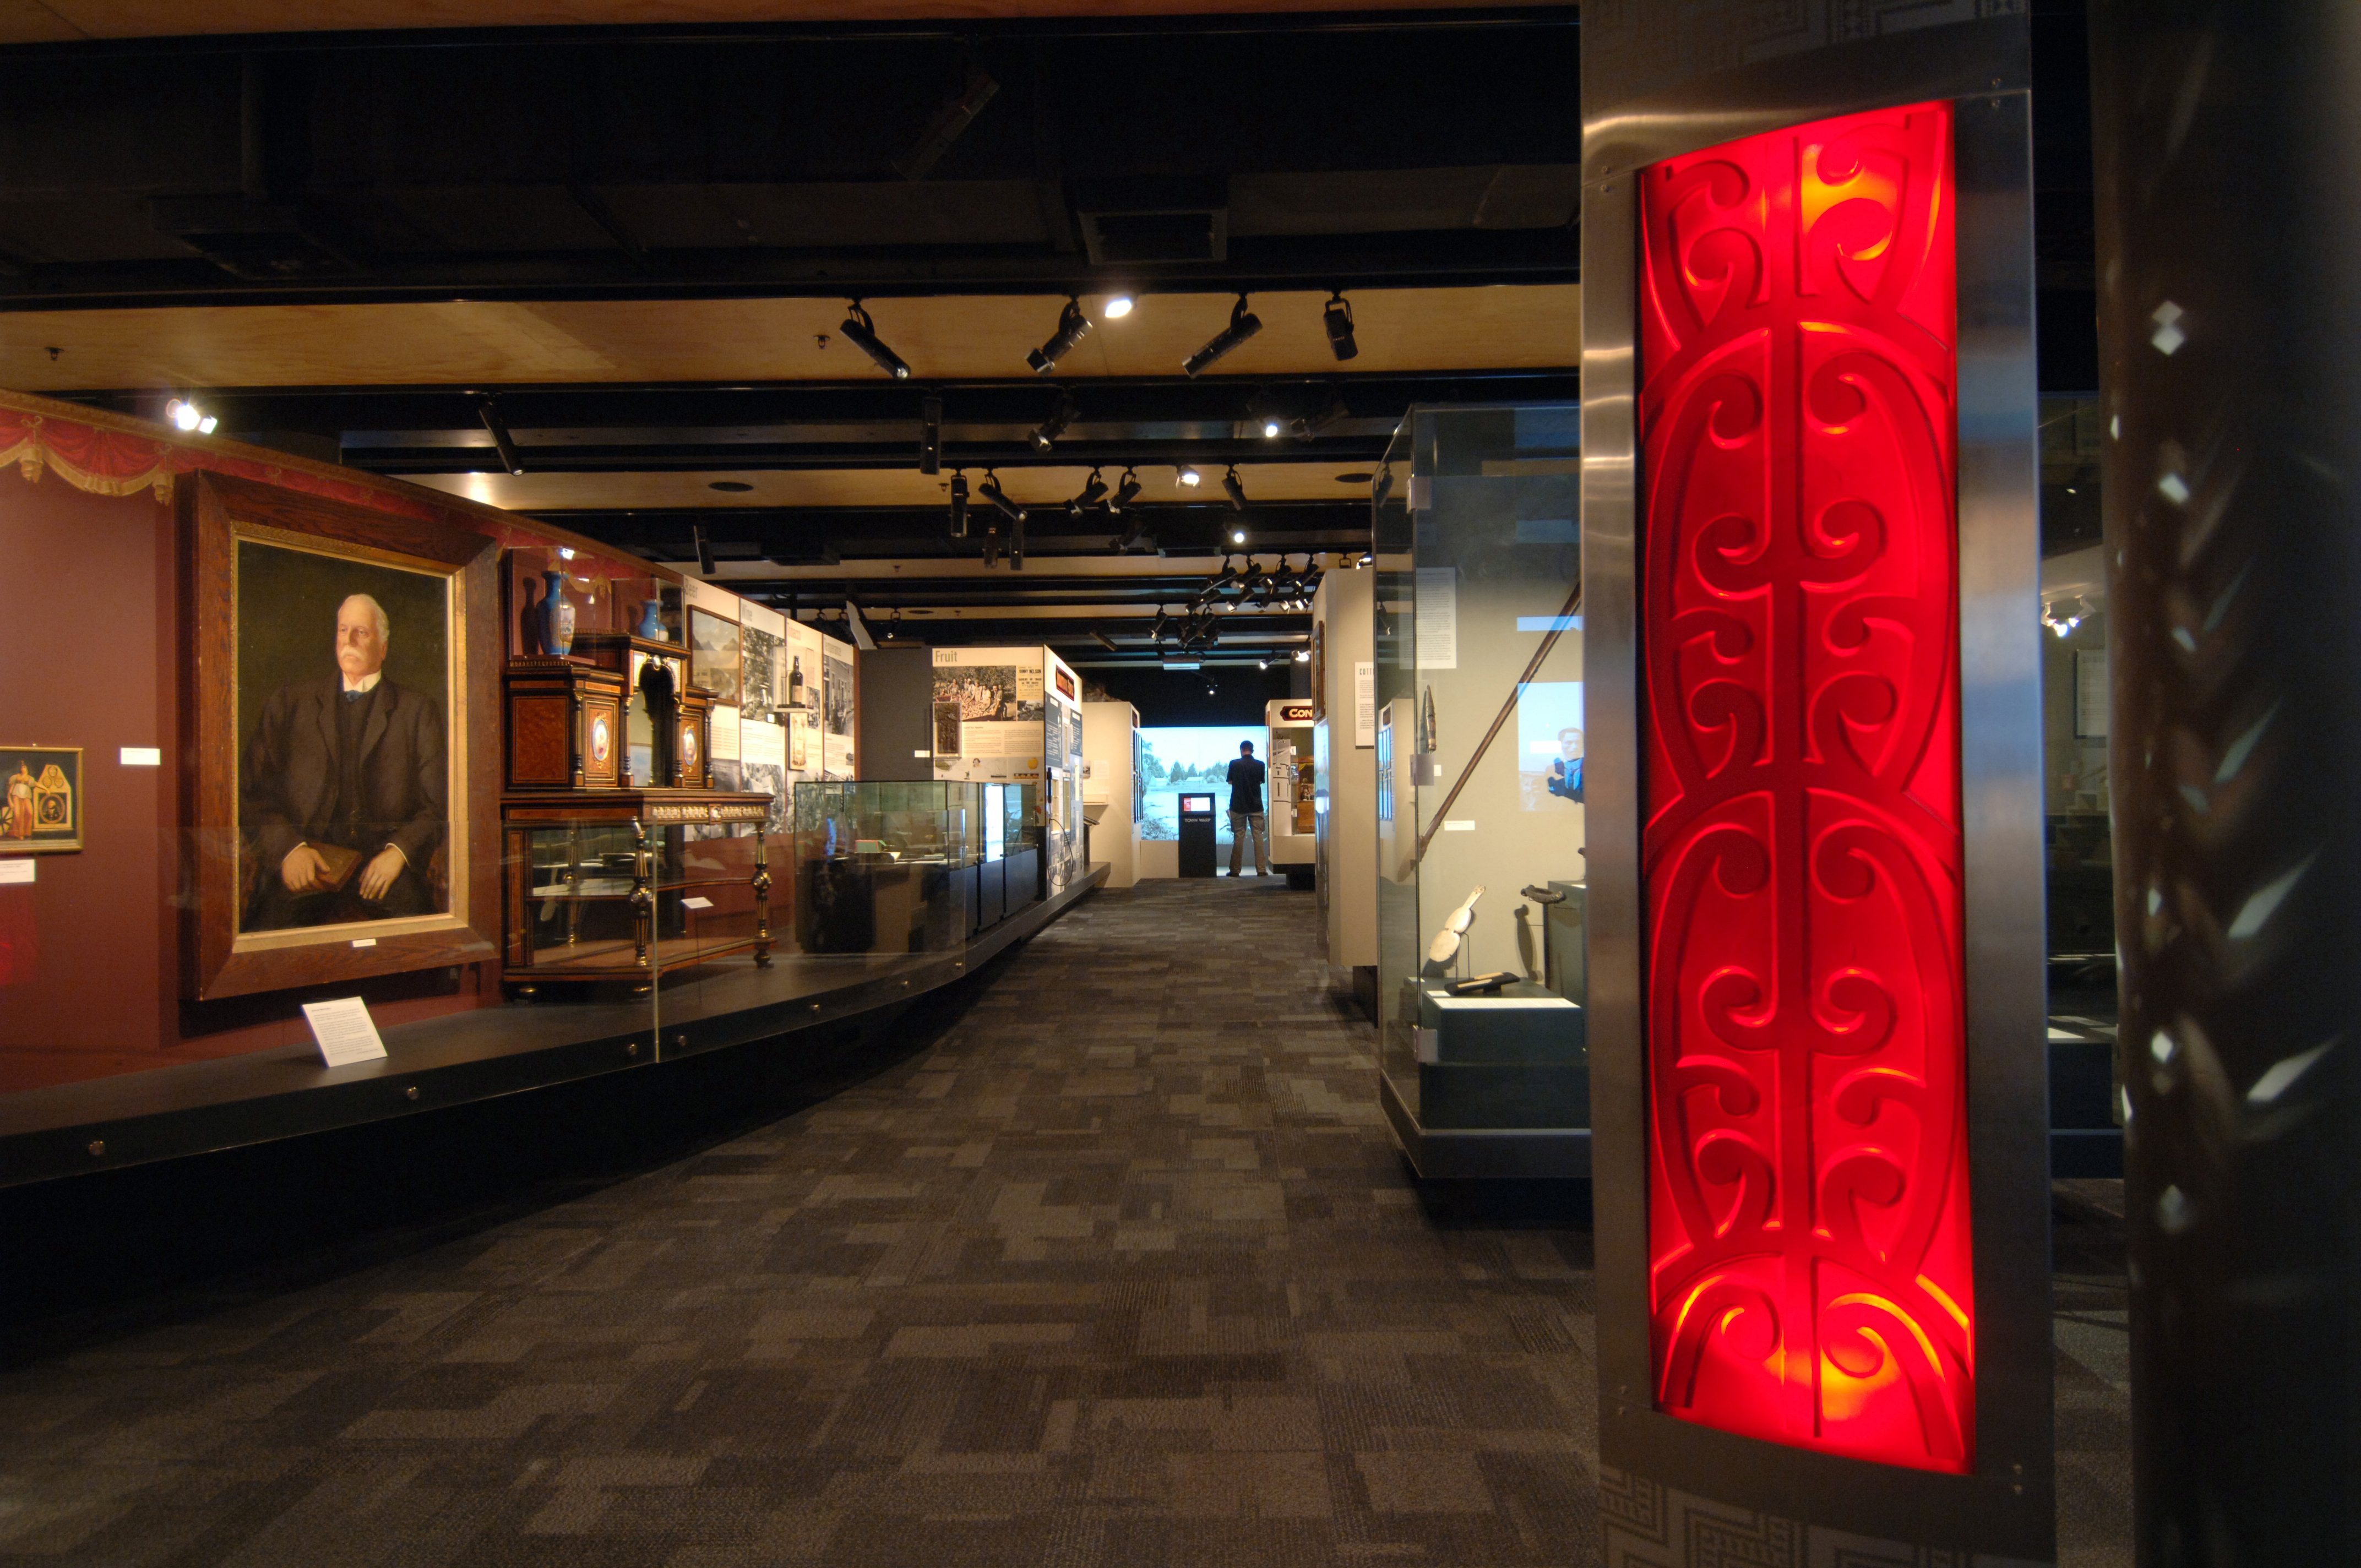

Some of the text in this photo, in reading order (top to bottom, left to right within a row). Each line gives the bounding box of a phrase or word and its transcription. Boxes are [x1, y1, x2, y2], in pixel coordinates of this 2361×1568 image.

[684, 578, 698, 599] Beer
[740, 602, 753, 622] Wine
[935, 650, 958, 662] Fruit
[1289, 708, 1313, 718] CON
